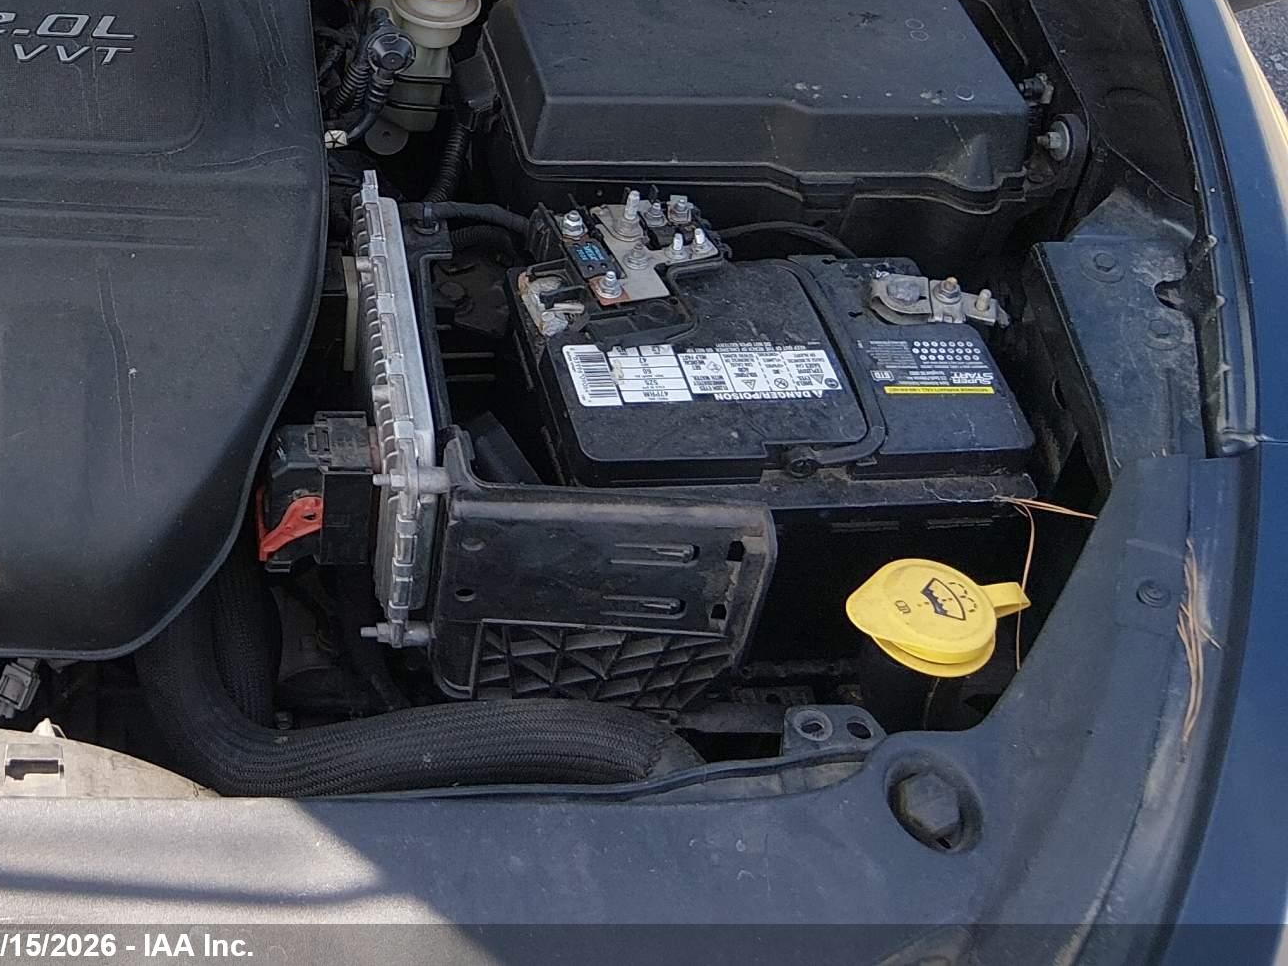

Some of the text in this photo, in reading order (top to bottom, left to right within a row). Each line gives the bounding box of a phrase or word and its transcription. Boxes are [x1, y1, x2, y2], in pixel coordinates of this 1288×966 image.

[13, 43, 134, 66] VVT
[951, 372, 994, 380] START
[714, 390, 812, 400] DANGER/POISON
